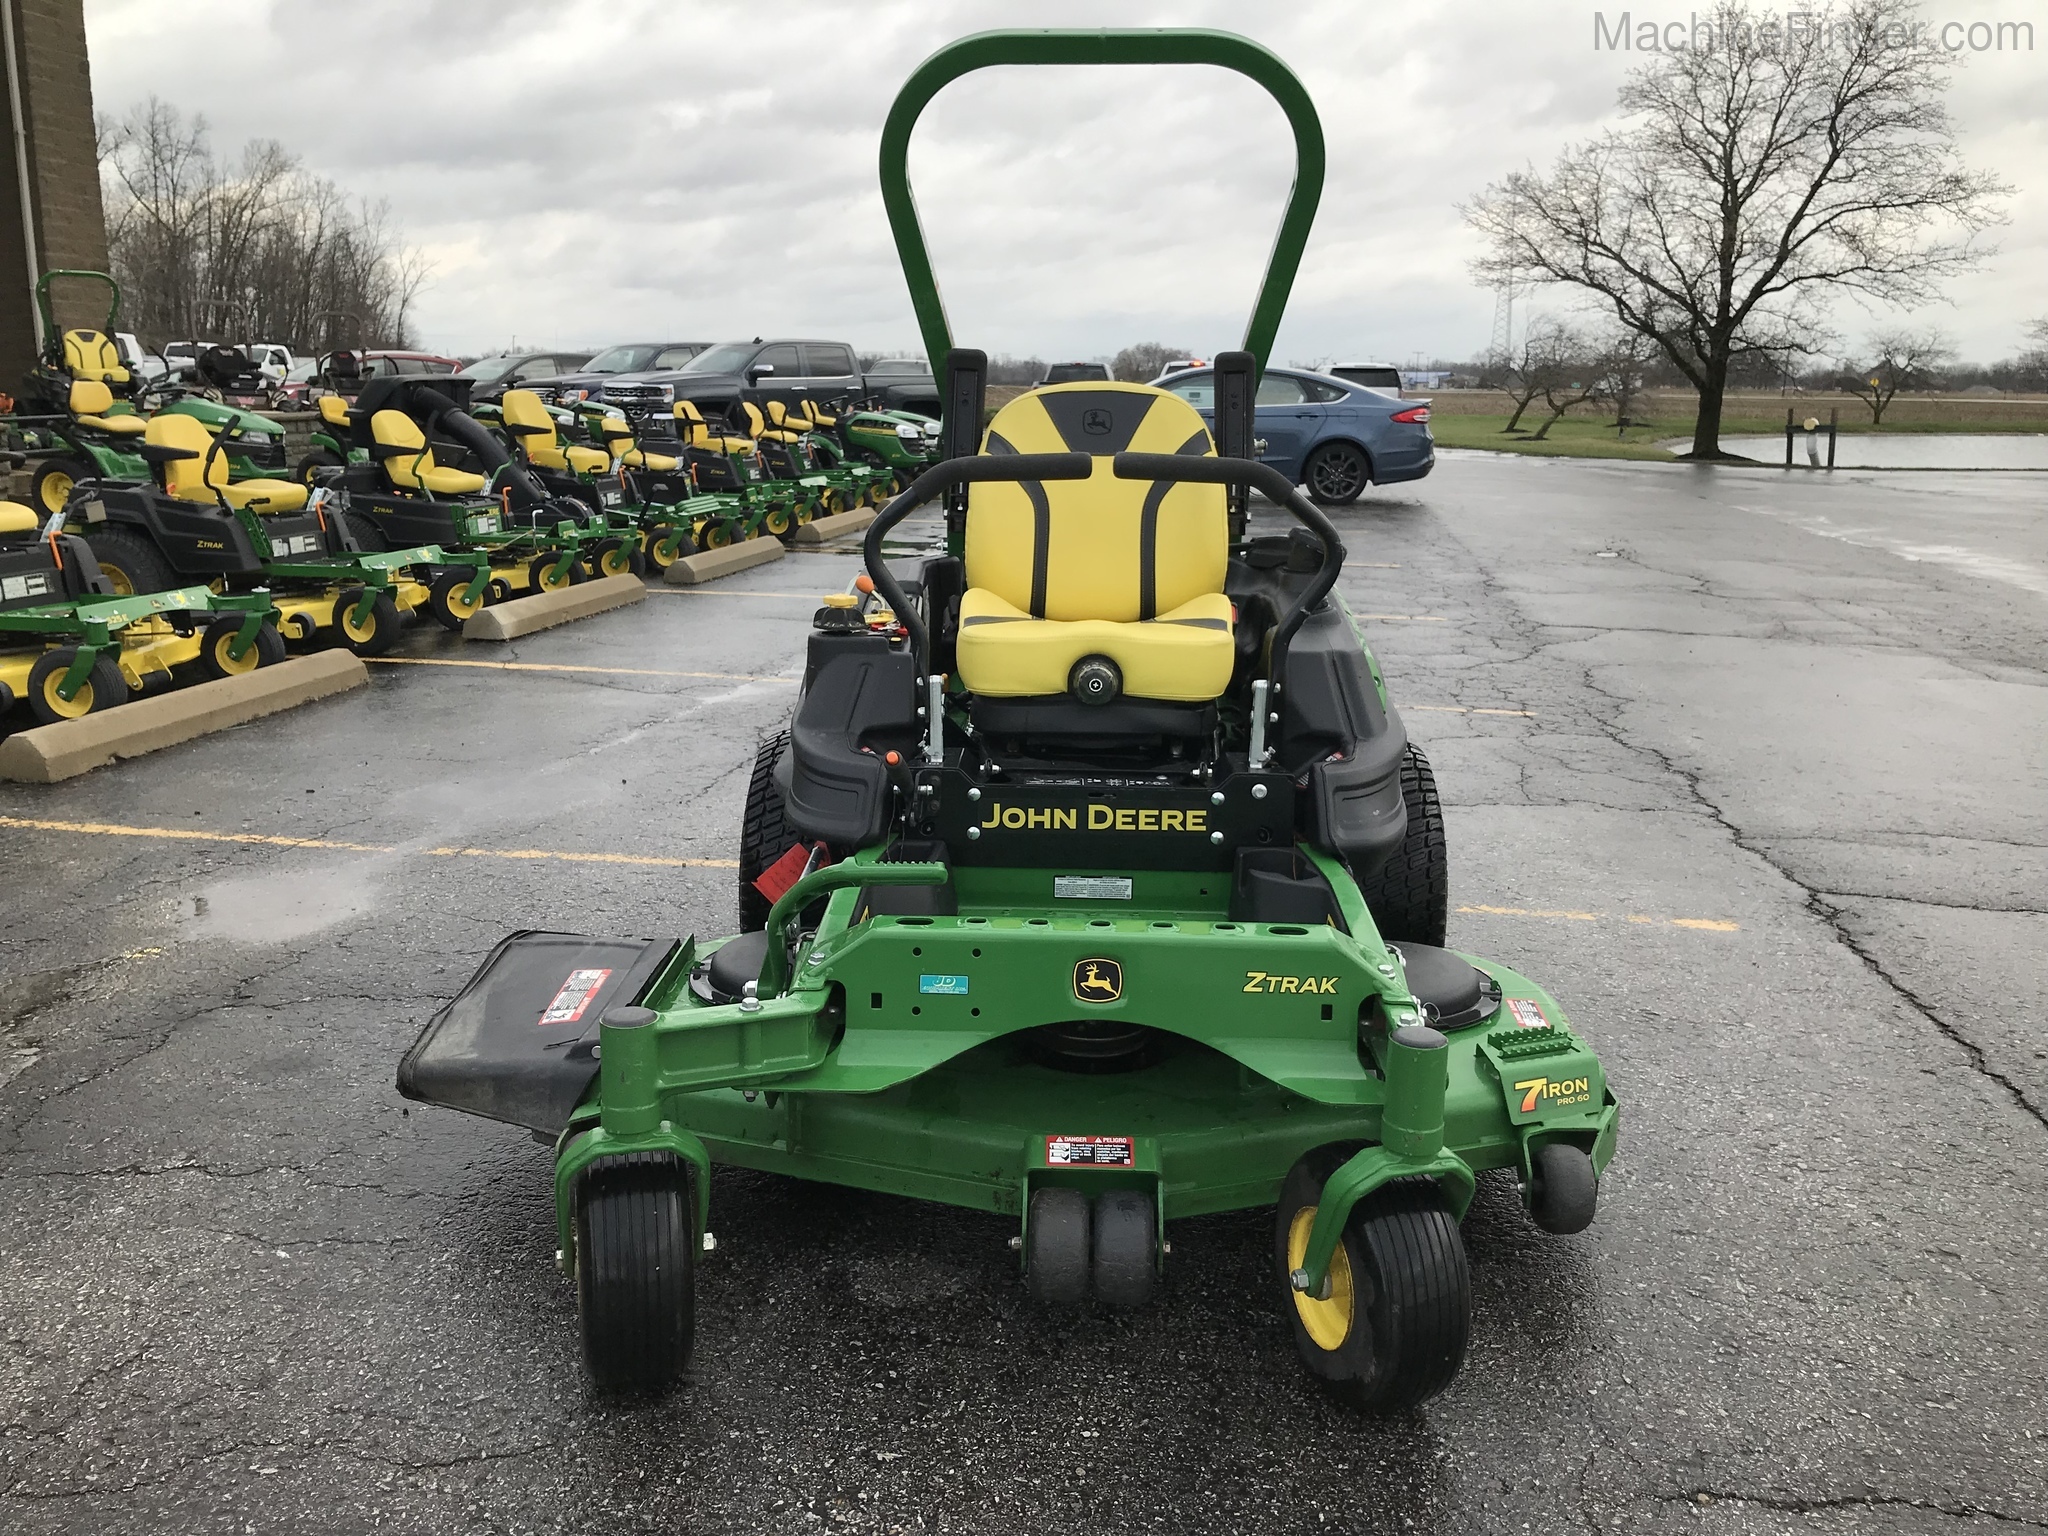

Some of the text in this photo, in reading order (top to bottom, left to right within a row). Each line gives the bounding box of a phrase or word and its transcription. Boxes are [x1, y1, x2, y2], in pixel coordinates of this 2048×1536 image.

[197, 540, 224, 549] ZTRAK
[982, 803, 1207, 831] JOHN DEERE
[1242, 971, 1340, 994] ZTRAK
[1557, 1094, 1590, 1106] PRO 60
